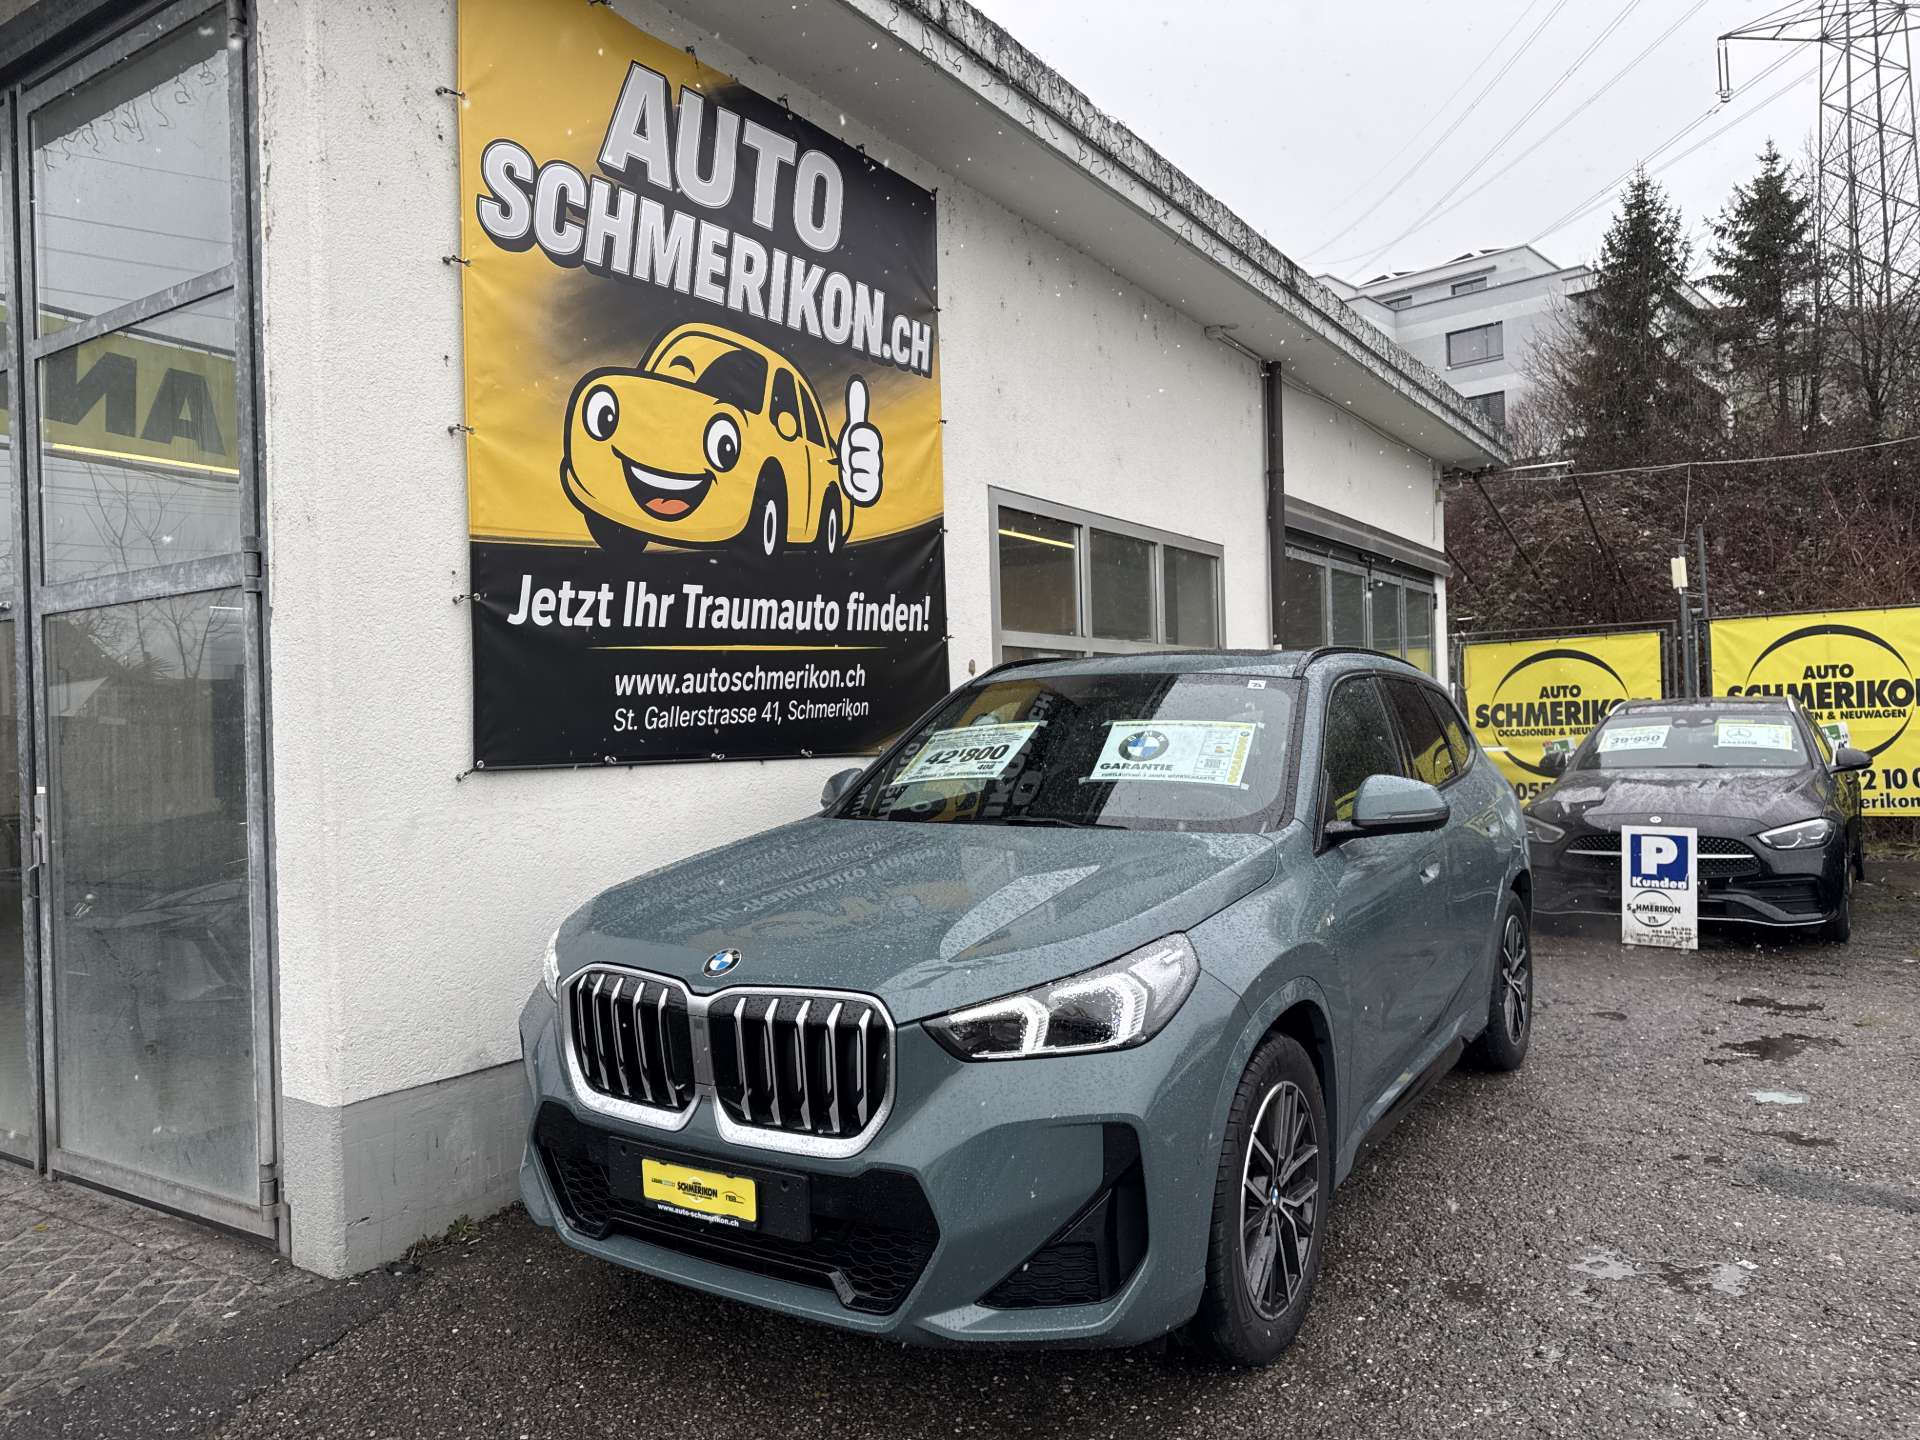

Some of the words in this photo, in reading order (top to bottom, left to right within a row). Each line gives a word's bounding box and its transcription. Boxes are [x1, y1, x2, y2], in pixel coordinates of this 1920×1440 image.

[600, 62, 844, 252] AUTO
[479, 142, 933, 372] SCHMERIKON.CH
[507, 574, 613, 627] Jetzt
[623, 581, 675, 628] Ihr
[682, 584, 840, 631] Traumauto
[847, 592, 931, 632] finden!
[614, 664, 867, 696] www.autoschmerikon.ch
[1803, 663, 1855, 680] AUTO
[1539, 684, 1582, 699] AUTO
[613, 707, 638, 732] St.
[644, 704, 757, 730] Gallerstrasse
[761, 701, 782, 725] 41,
[788, 698, 869, 720] Schmerikon
[1827, 711, 1836, 720] &
[1839, 708, 1907, 720] NEUWAGEN
[1497, 728, 1556, 738] OCCASIONEN
[1558, 727, 1566, 736] &
[924, 744, 1011, 765] 42'800
[1099, 762, 1175, 773] GARANTIE
[1882, 768, 1908, 790] 10
[1640, 835, 1679, 876] P
[1631, 876, 1688, 890] Kunden
[677, 1181, 718, 1199] SCHMERIKON
[657, 1203, 739, 1227] www.auto-schmerikon.ch
